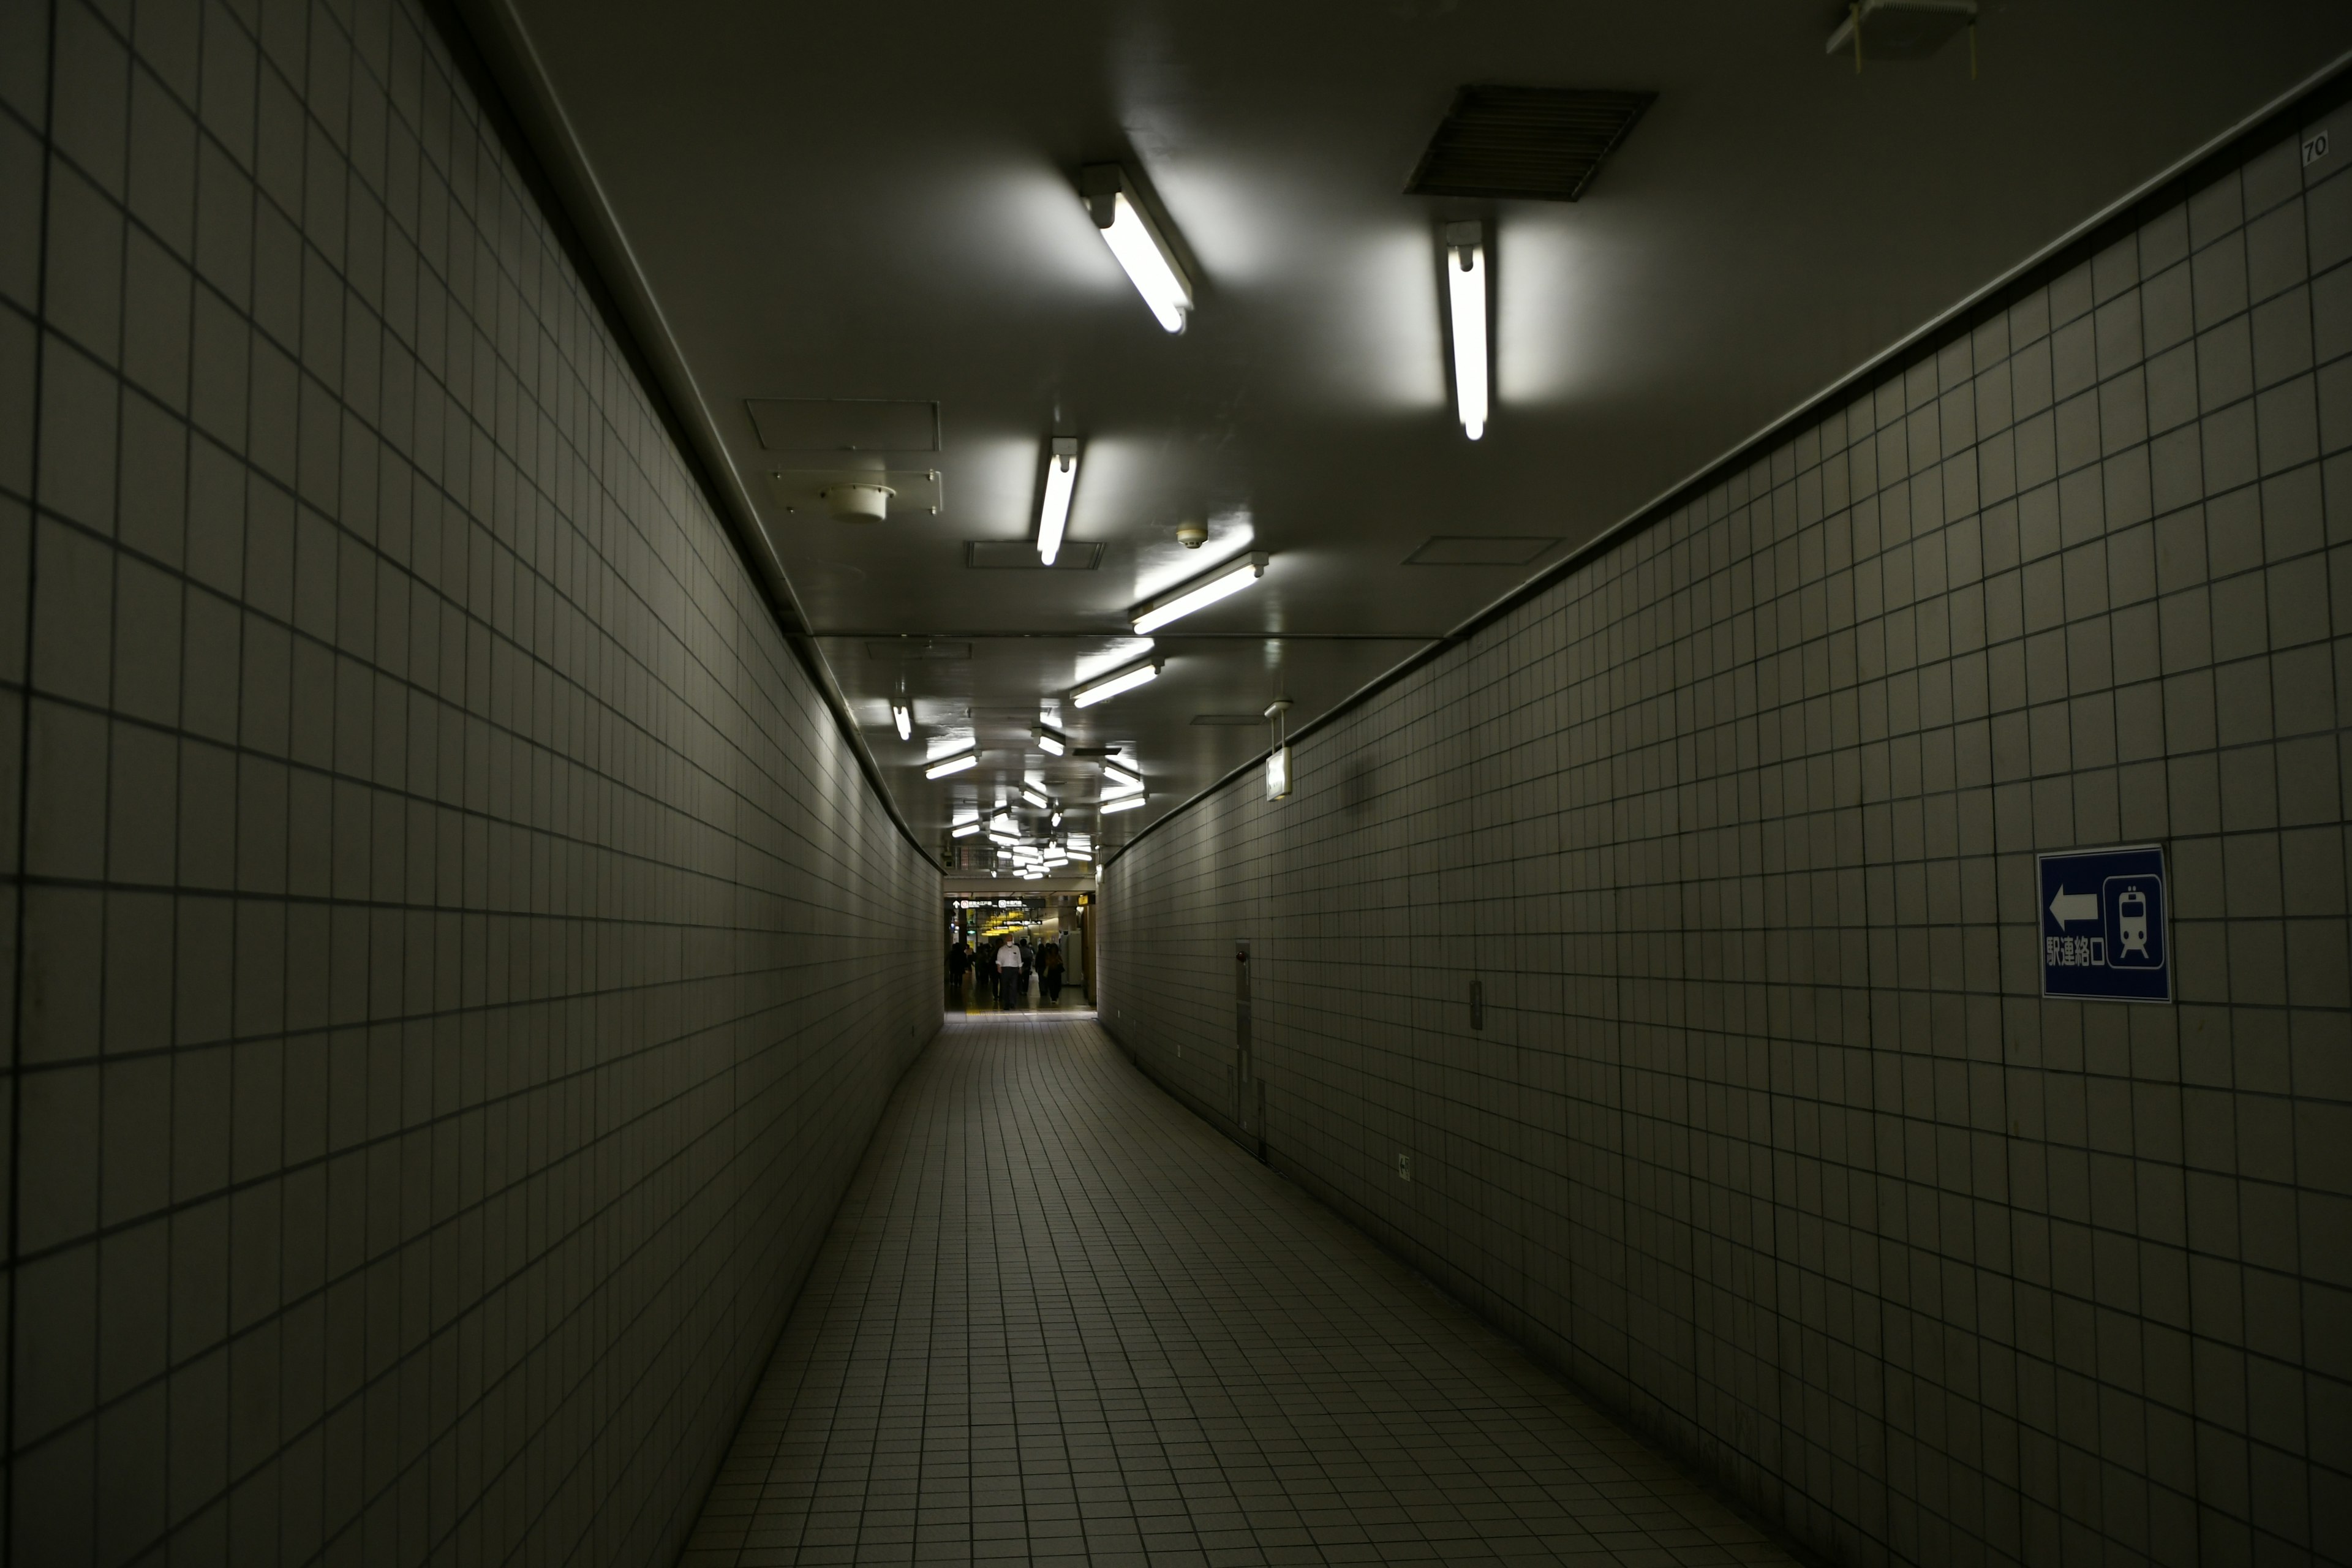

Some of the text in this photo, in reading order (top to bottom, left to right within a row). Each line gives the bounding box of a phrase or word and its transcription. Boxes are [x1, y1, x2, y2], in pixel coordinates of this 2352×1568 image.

[2304, 135, 2326, 162] 70
[2046, 936, 2106, 967] 駅連絡口
